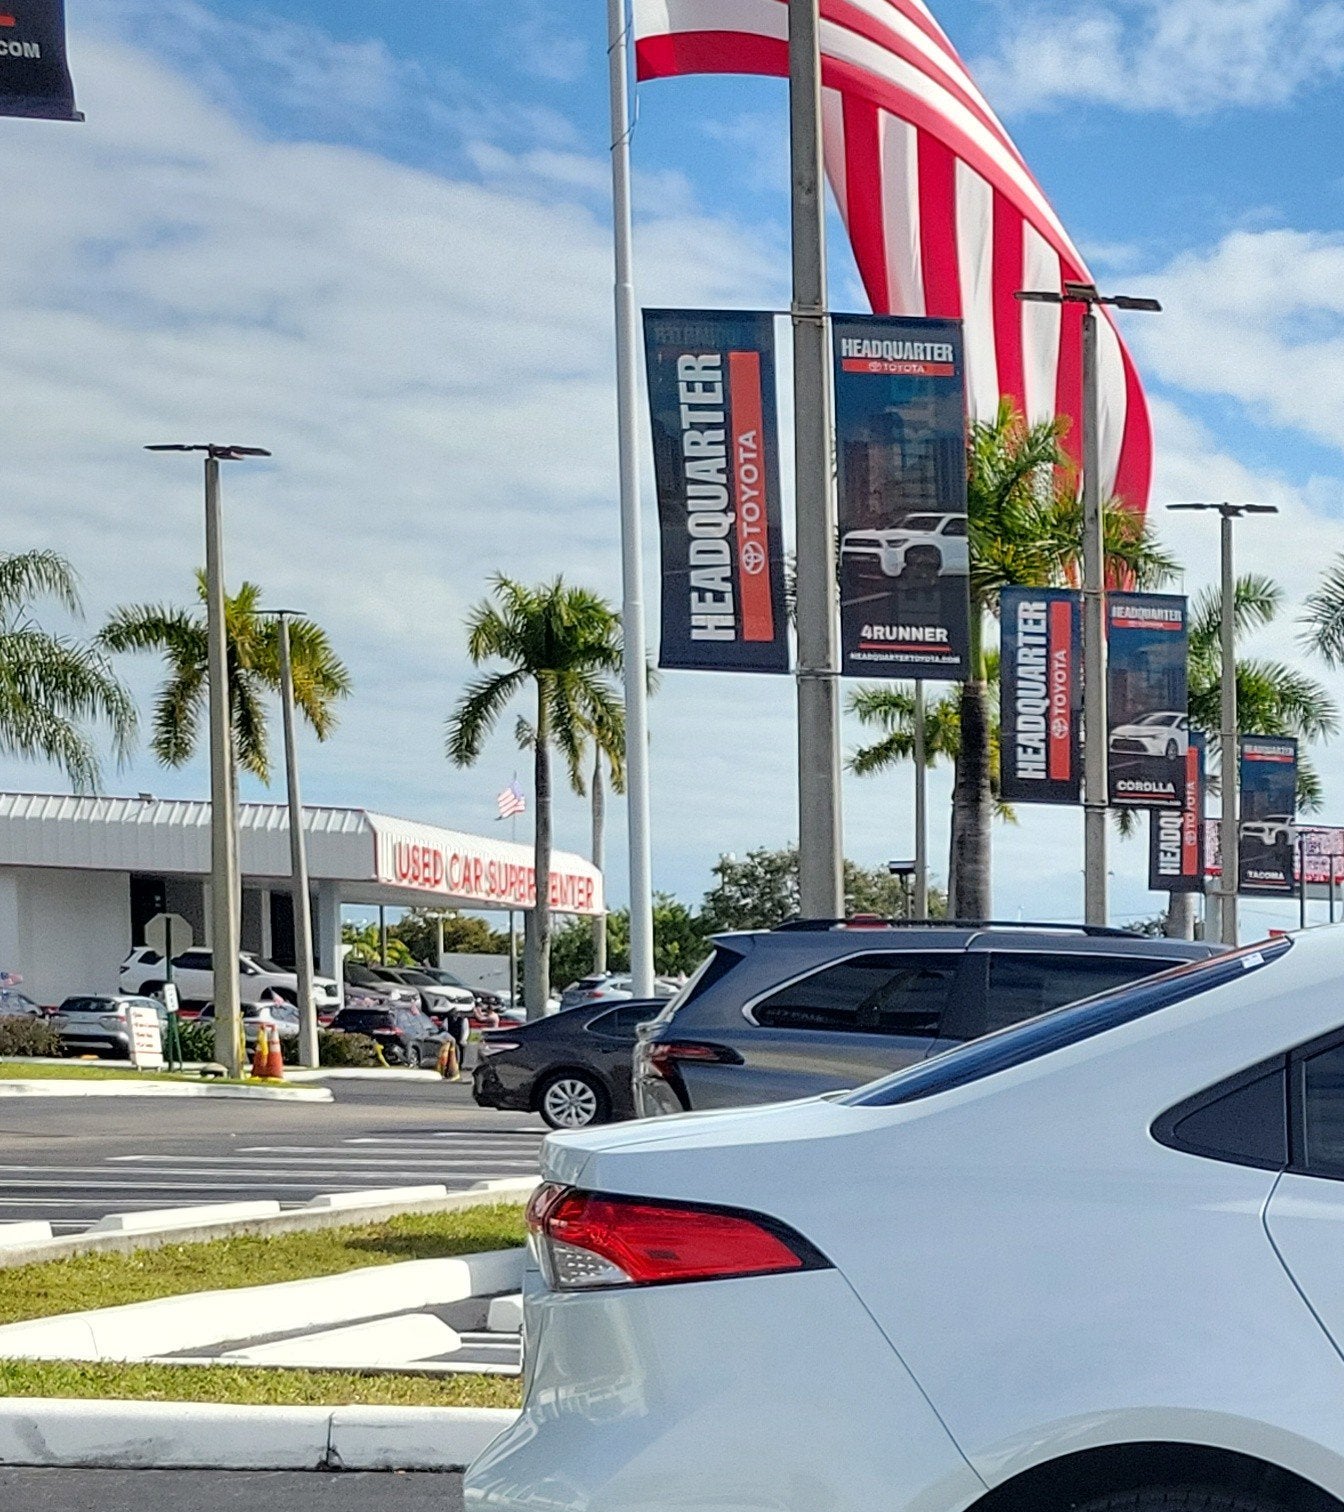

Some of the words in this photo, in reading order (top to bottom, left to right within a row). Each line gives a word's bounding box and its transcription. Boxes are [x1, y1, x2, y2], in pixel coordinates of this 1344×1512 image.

[841, 338, 954, 362] HEADQUARTER
[883, 364, 925, 374] TOYOTA
[677, 353, 736, 642] HEADQUARTER
[737, 430, 763, 538] TOYOTA
[860, 624, 949, 643] 4RUNNER
[1016, 601, 1050, 780] HEADQUARTER
[1051, 649, 1068, 719] TOYOTA
[1116, 780, 1176, 794] COROLLA
[395, 842, 445, 886] USED
[449, 852, 484, 892] CAR
[487, 859, 536, 902] SUPER
[549, 871, 596, 910] ENTER
[1247, 870, 1285, 880] TACOMA
